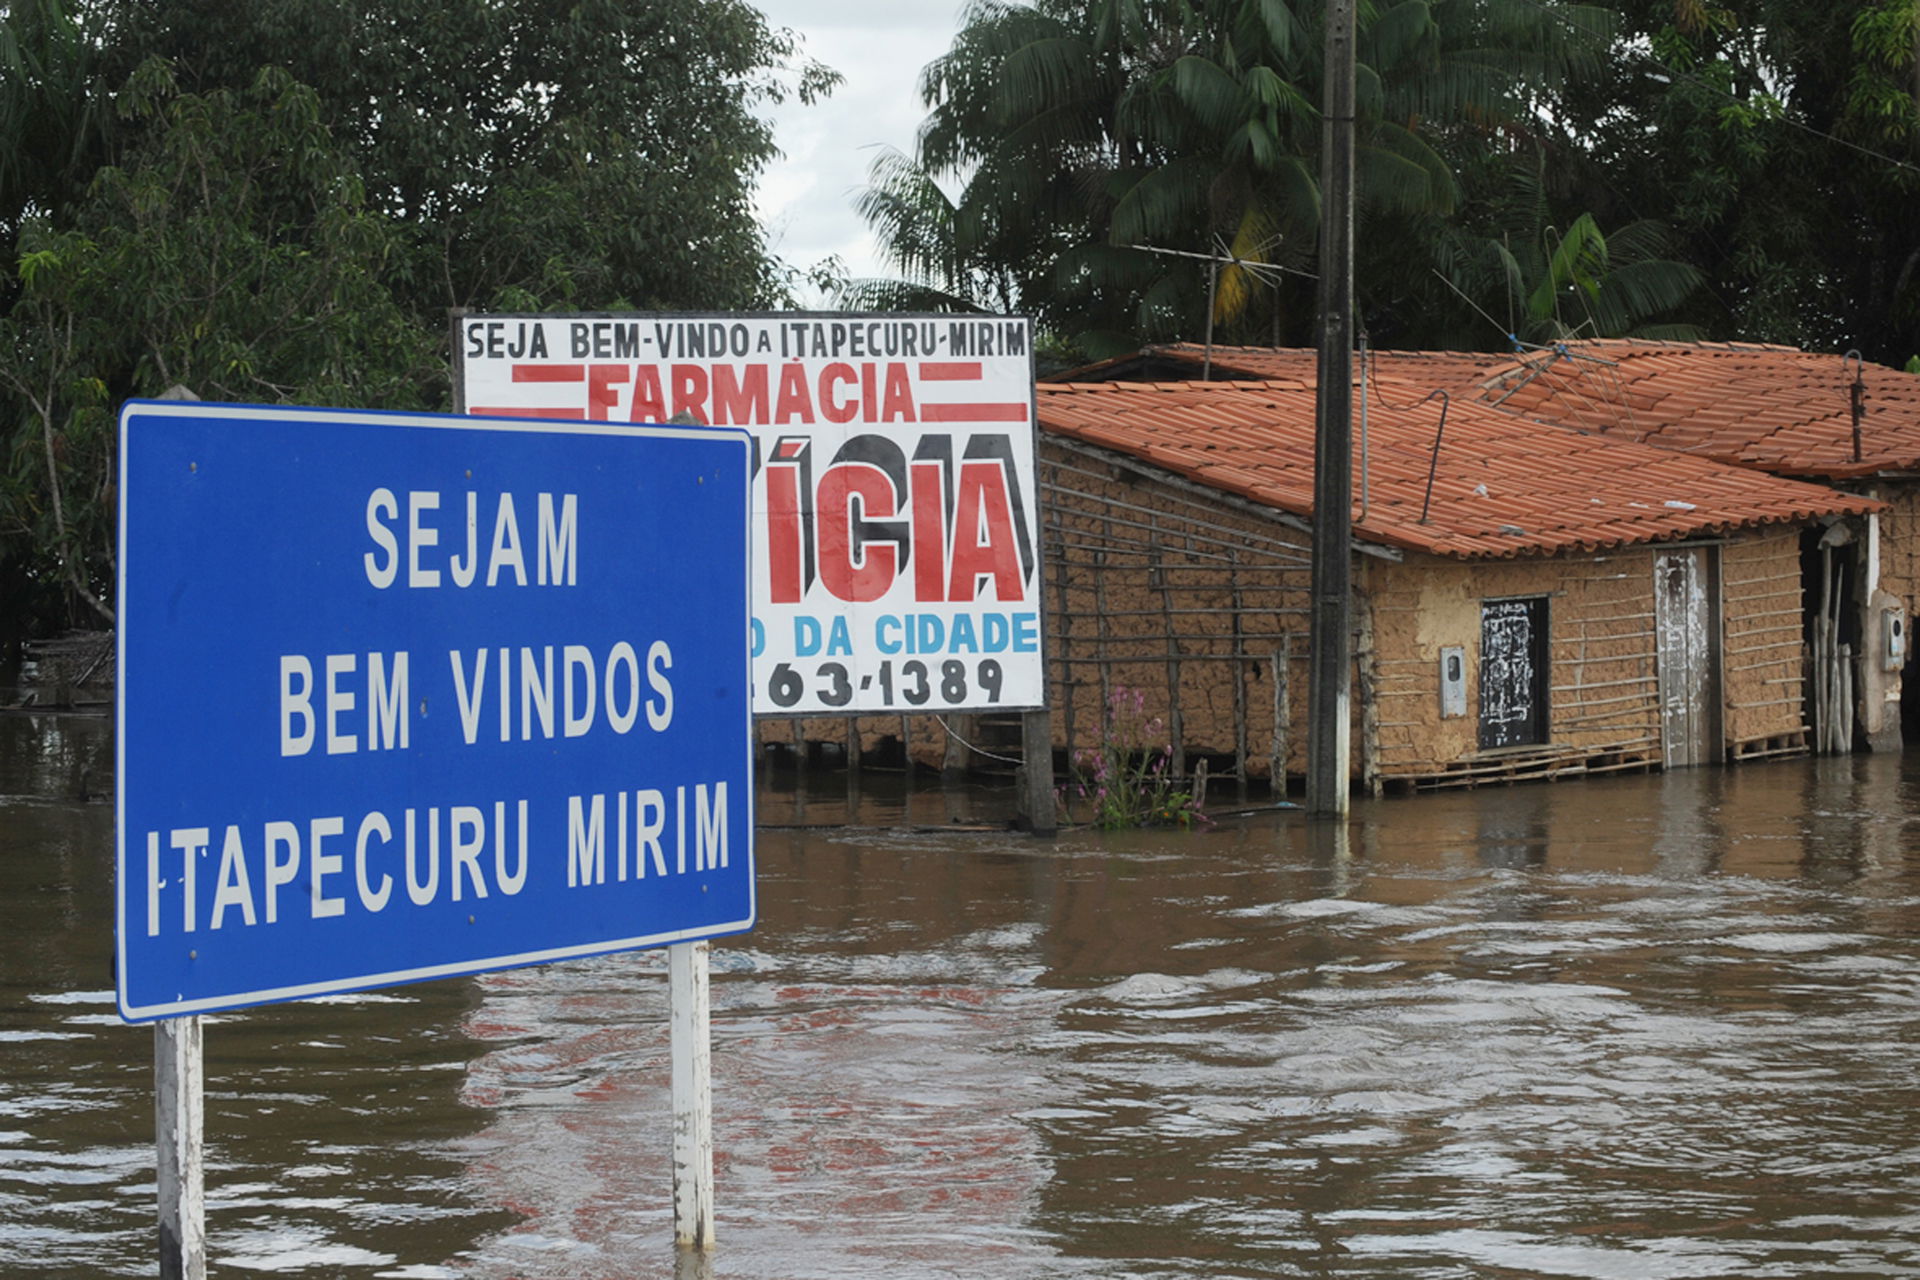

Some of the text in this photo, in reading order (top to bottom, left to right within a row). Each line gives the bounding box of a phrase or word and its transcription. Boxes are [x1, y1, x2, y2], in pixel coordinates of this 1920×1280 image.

[467, 322, 1026, 358] SEJA BEM-VINDO A ITAPECURU-MIRIM
[588, 357, 917, 425] FARMÁCIA
[364, 488, 578, 589] SEJAM
[752, 433, 1035, 604] ÍCIA
[794, 615, 853, 657] DA
[876, 612, 1038, 655] CIDADE
[280, 640, 675, 757] BEM VINDOS
[752, 658, 1003, 707] 63-1389
[147, 782, 730, 937] ITAPECURU MIRIM
